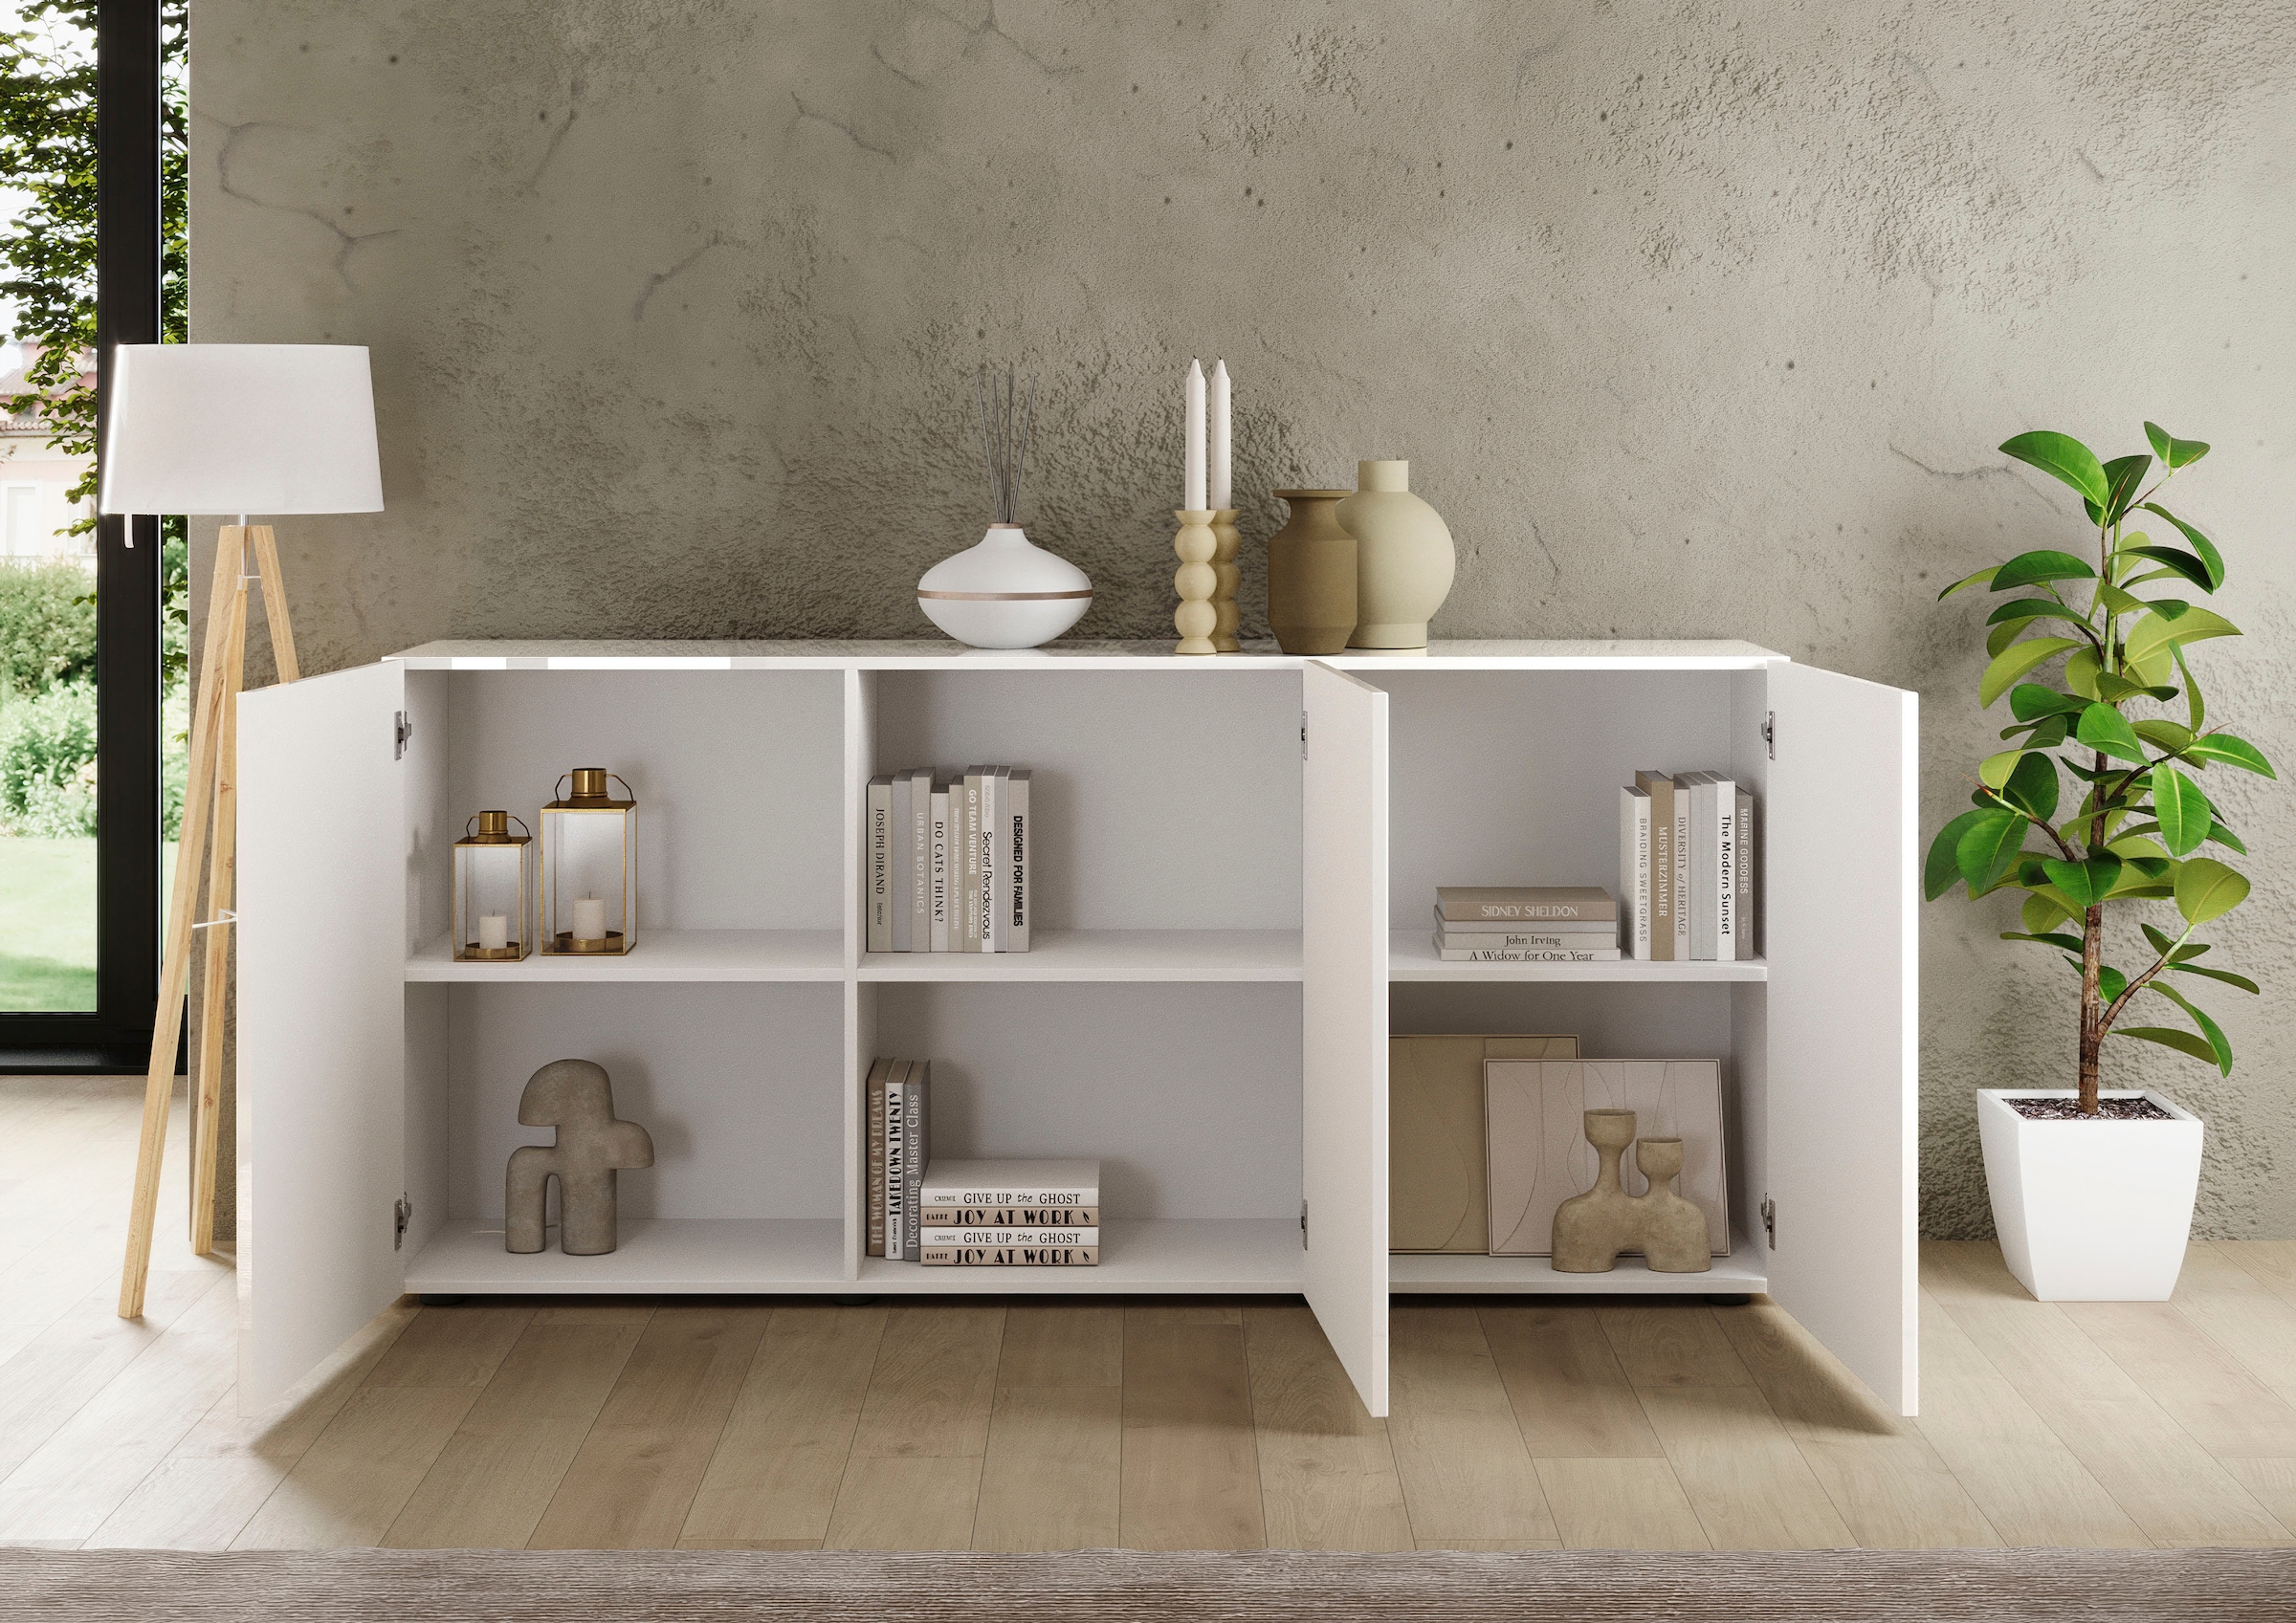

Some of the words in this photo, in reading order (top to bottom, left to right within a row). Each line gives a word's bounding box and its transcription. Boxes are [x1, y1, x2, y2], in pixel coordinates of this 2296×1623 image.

[968, 790, 976, 803] GO
[875, 808, 885, 848] JOSEPH
[935, 822, 943, 838] DO
[968, 806, 977, 831] TEAM
[1721, 815, 1731, 837] The
[982, 831, 992, 867] Secret
[1013, 816, 1023, 862] DESIGNED
[875, 852, 885, 894] DIRAND
[935, 844, 943, 873] CATS
[1659, 826, 1667, 916] MUSTERZIMMER
[1721, 842, 1731, 888] Modern
[1013, 866, 1023, 884] FOR
[1677, 874, 1686, 883] of
[935, 878, 943, 923] THINK?
[982, 871, 992, 939] Rendezvous
[1013, 886, 1023, 926] FAMILIES
[1482, 906, 1521, 917] SIDNEY
[1525, 906, 1578, 917] SHELDON
[1721, 894, 1731, 935] Sunset
[1469, 952, 1477, 960] A
[1482, 951, 1521, 960] Widow
[1524, 951, 1539, 960] for
[1543, 952, 1566, 960] One
[1570, 952, 1594, 960] Year
[1505, 935, 1528, 947] John
[1532, 935, 1560, 947] Irving
[872, 1090, 882, 1136] DREAMS
[889, 1091, 901, 1143] TWENTY
[906, 1094, 918, 1128] Class
[872, 1139, 882, 1155] MY
[907, 1132, 918, 1174] Master
[872, 1160, 882, 1174] OF
[889, 1148, 901, 1216] TAKEDOWN
[872, 1177, 883, 1220] WOMAN
[906, 1180, 921, 1247] Decorating
[963, 1194, 992, 1204] GIVE
[997, 1194, 1011, 1203] UP
[1017, 1194, 1032, 1203] the
[1039, 1194, 1080, 1204] GHOST
[954, 1210, 986, 1224] JOY
[994, 1210, 1015, 1224] AT
[1024, 1210, 1074, 1224] WORK
[872, 1223, 882, 1245] THE
[963, 1233, 992, 1243] GIVE
[997, 1233, 1011, 1242] UP
[1017, 1233, 1032, 1242] the
[1039, 1233, 1080, 1243] GHOST
[954, 1249, 986, 1263] JOY
[994, 1249, 1015, 1263] AT
[1024, 1249, 1074, 1263] WORK
